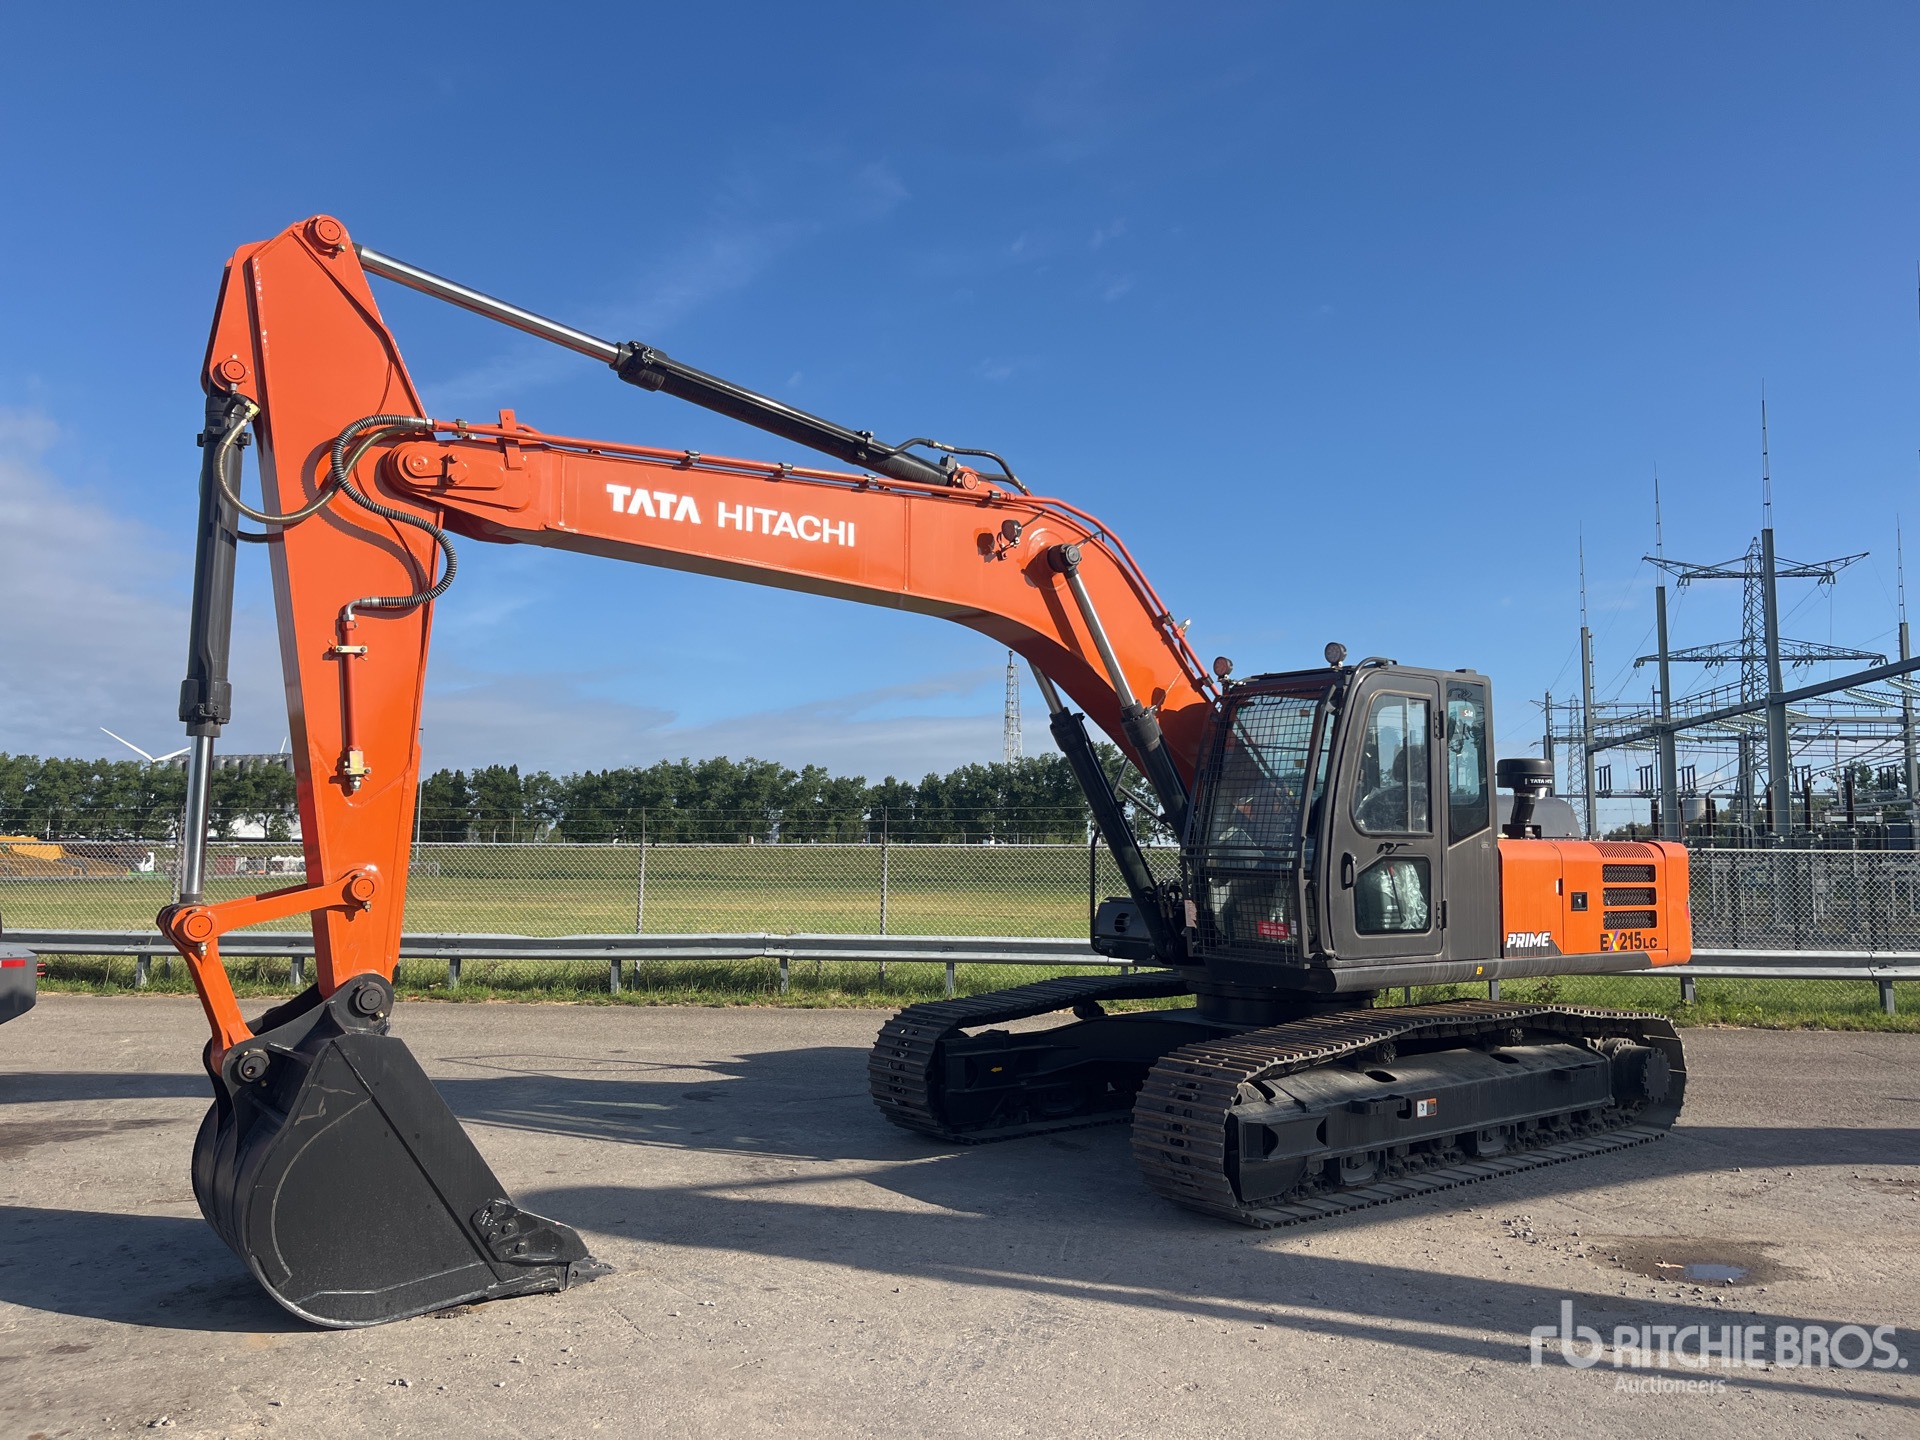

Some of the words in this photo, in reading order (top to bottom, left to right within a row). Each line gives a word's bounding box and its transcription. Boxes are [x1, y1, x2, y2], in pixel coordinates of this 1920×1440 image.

[606, 483, 701, 524] TATA
[717, 501, 855, 547] HITACHI
[1506, 932, 1551, 948] PRIME
